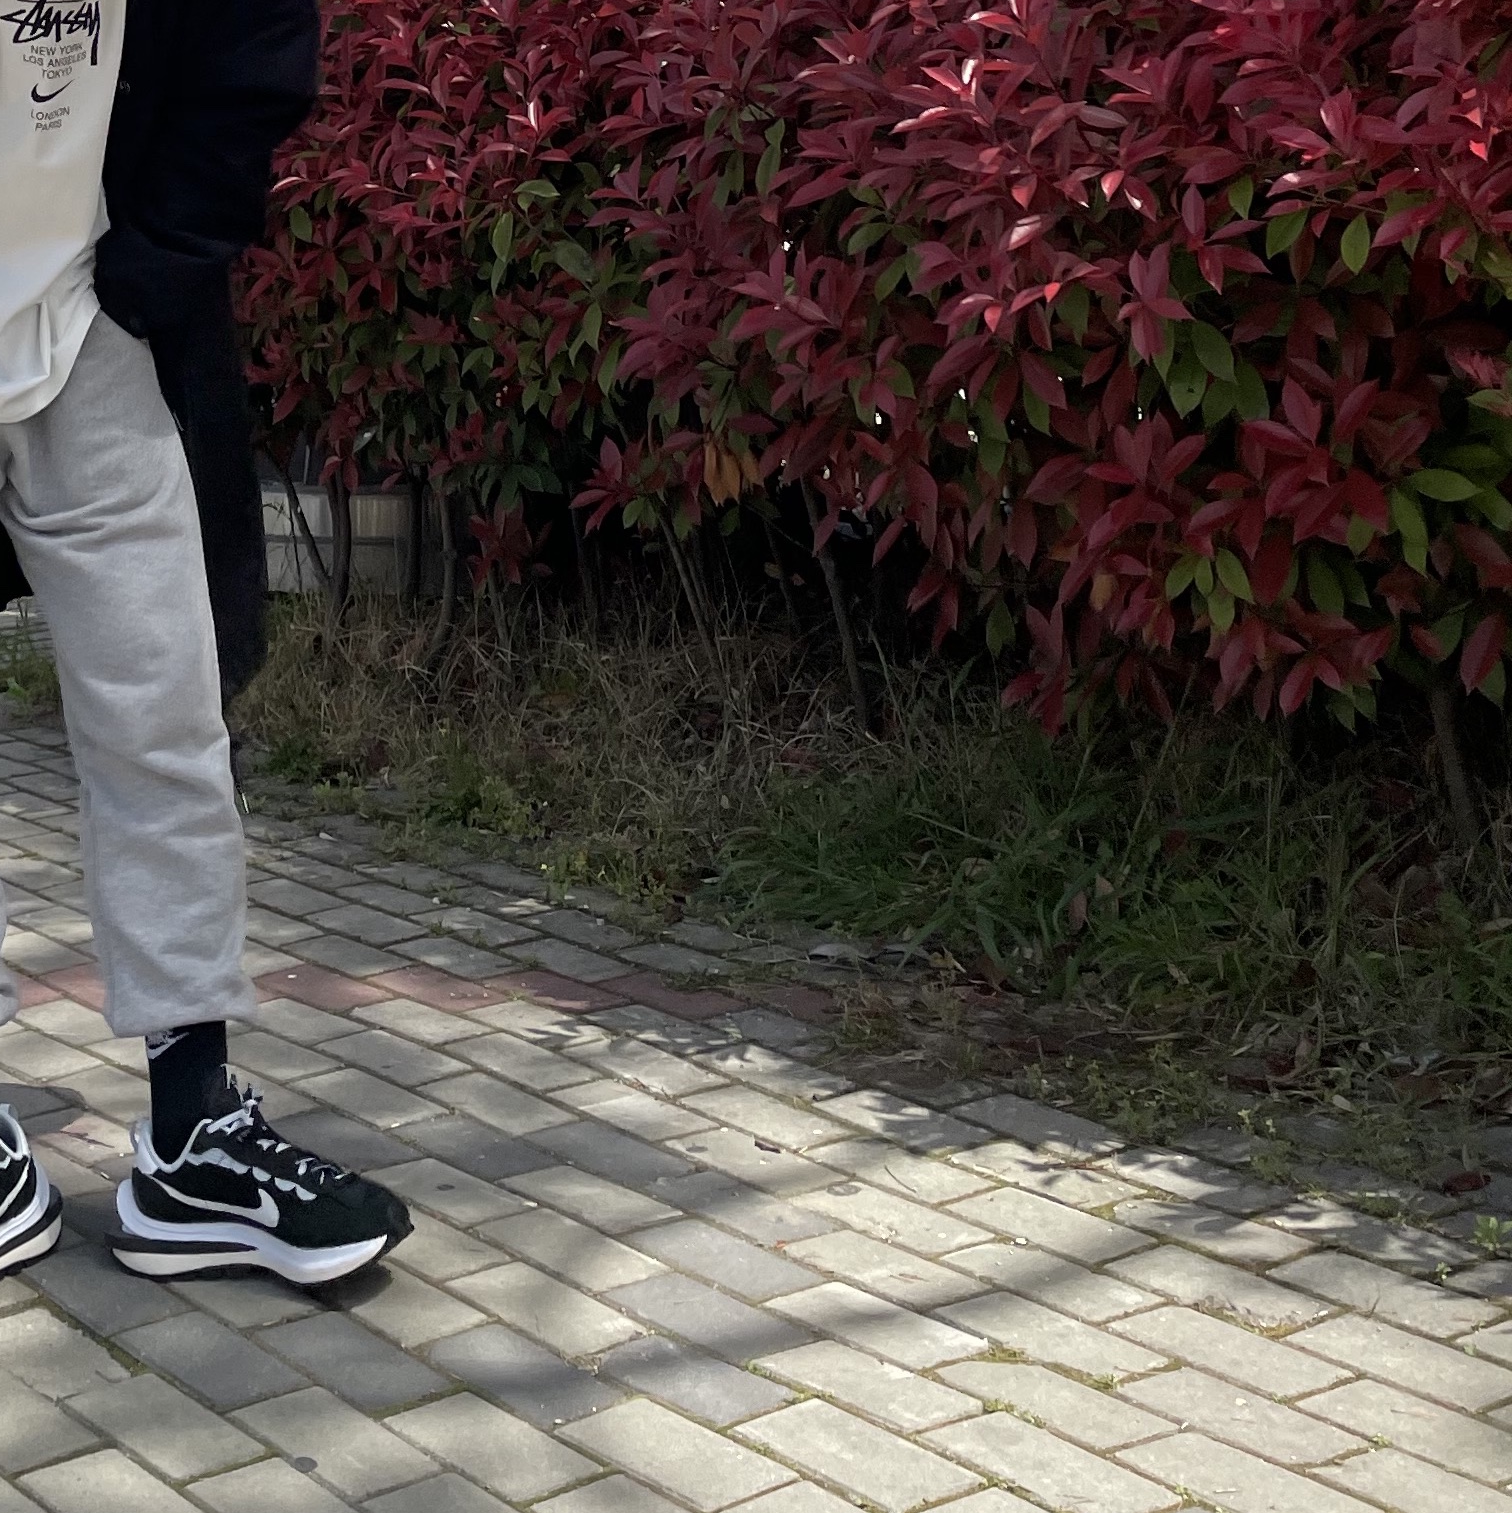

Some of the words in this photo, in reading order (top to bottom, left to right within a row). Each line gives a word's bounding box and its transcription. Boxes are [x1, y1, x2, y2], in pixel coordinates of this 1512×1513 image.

[30, 43, 57, 56] NEW
[59, 42, 83, 55] YORK
[22, 53, 44, 67] LOS
[46, 50, 87, 68] ANGELES
[41, 65, 73, 80] TOKYO
[30, 105, 70, 121] LONDON
[34, 118, 62, 132] PARIS
